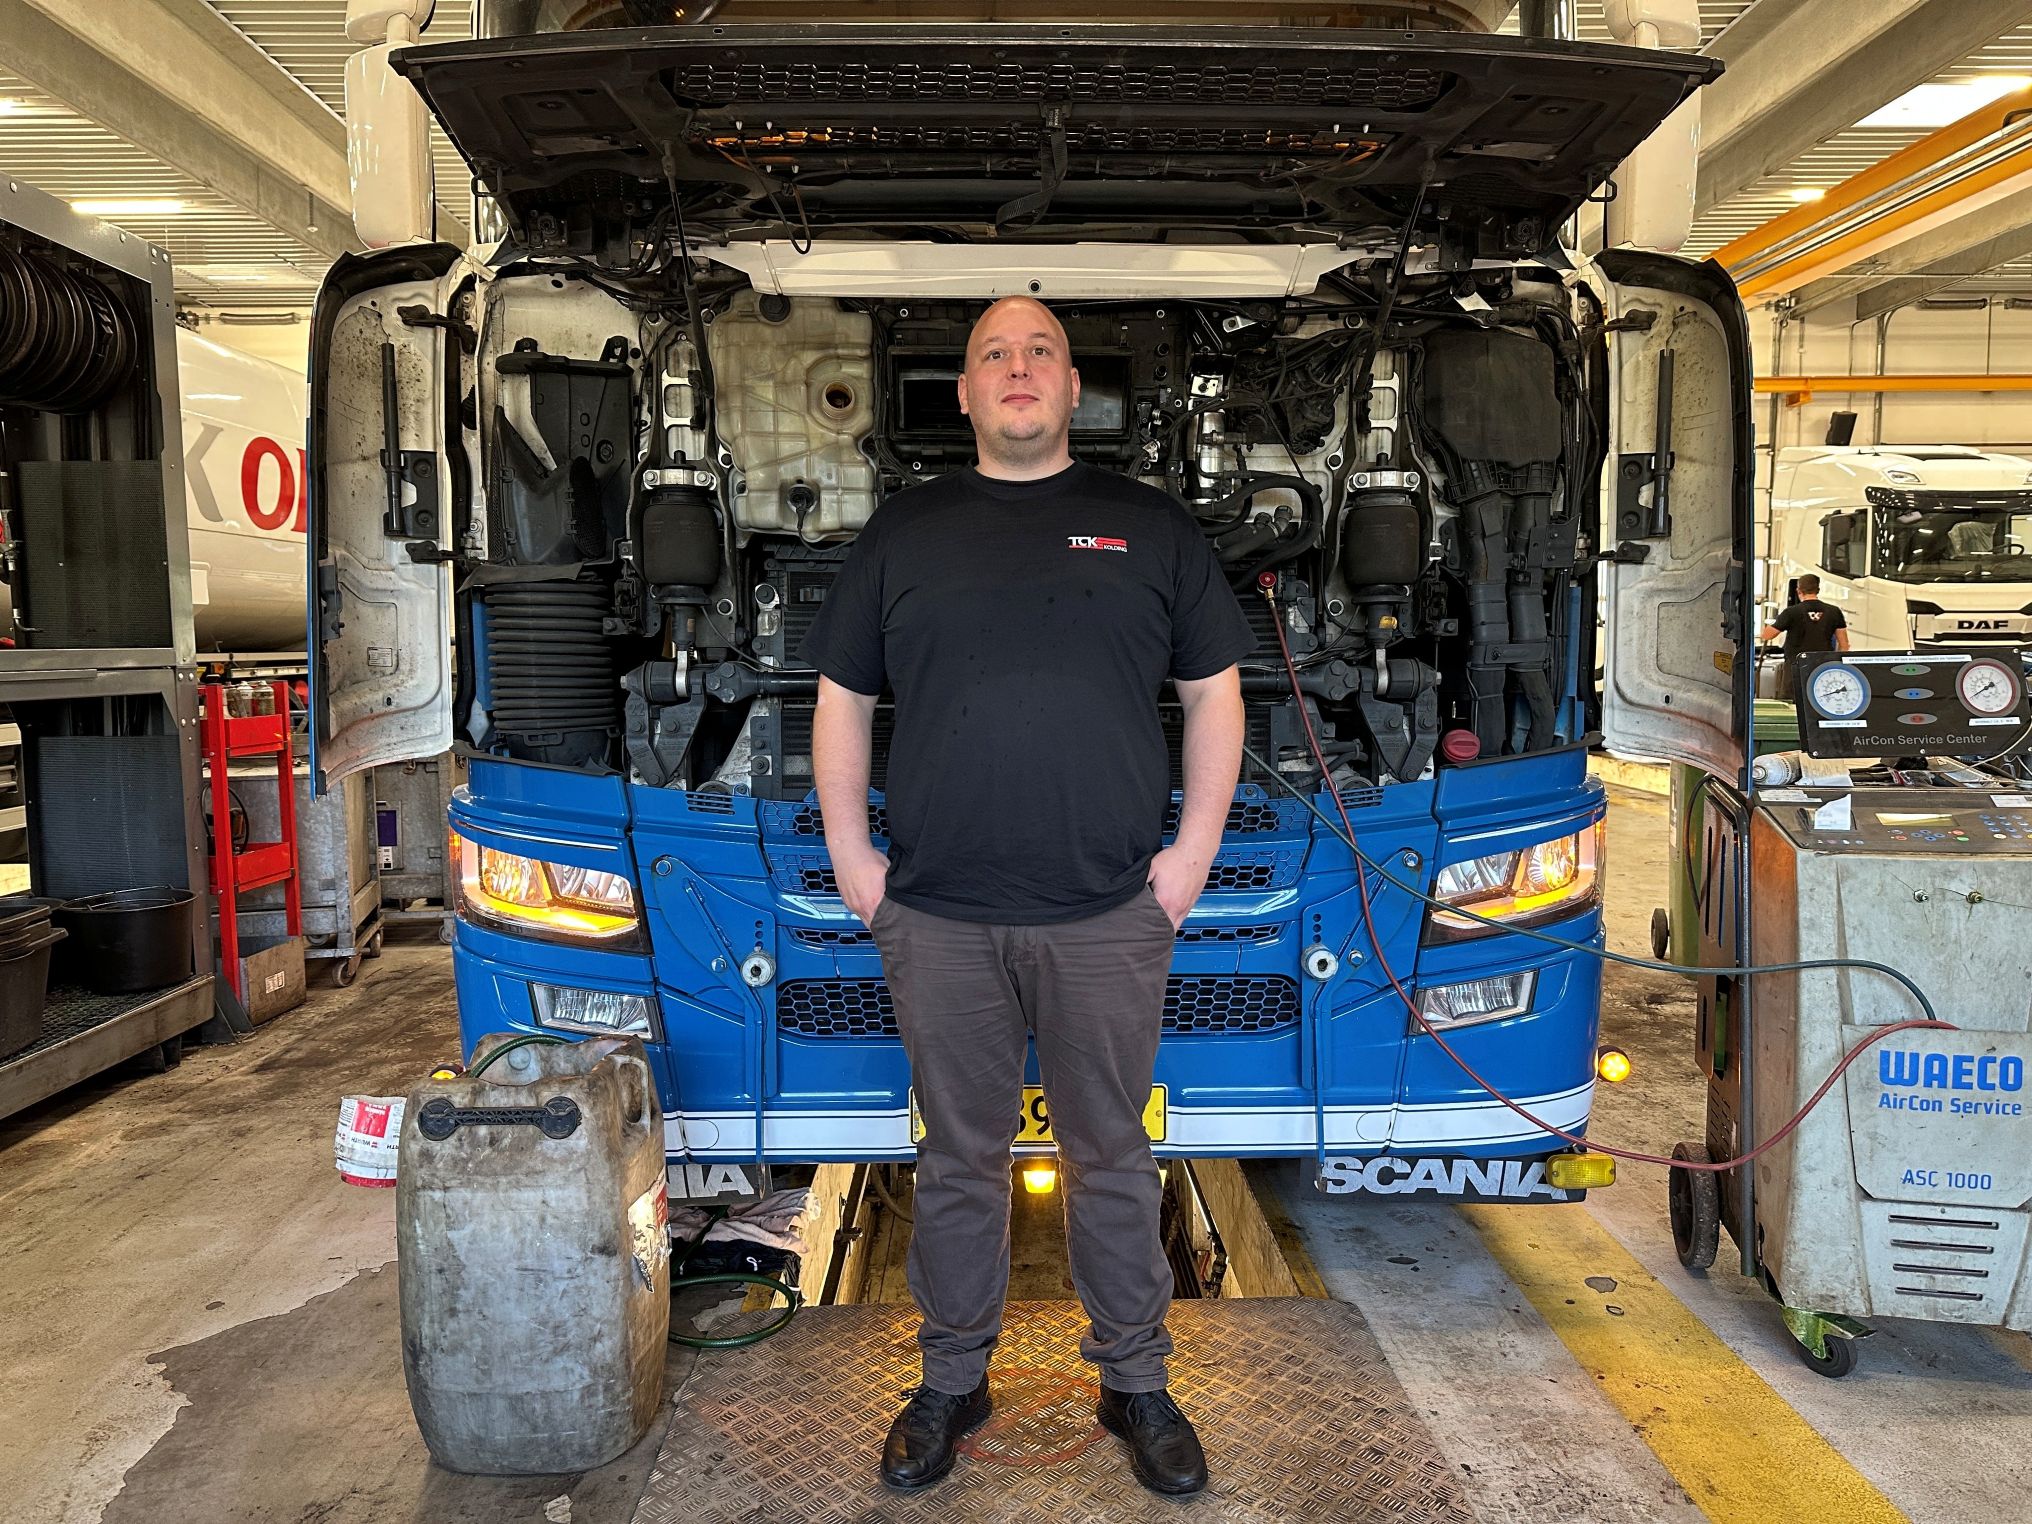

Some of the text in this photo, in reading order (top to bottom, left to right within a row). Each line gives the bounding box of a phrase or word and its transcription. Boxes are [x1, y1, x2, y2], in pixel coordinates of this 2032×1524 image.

[1067, 536, 1098, 548] TCK
[1103, 544, 1128, 552] KOLDING
[1957, 620, 2009, 630] DAF
[1853, 733, 1988, 746] AirCon Service Center
[1879, 1049, 2023, 1092] WAECO
[1878, 1093, 2022, 1116] AirCon Service
[1902, 1169, 1992, 1190] ASC 1000
